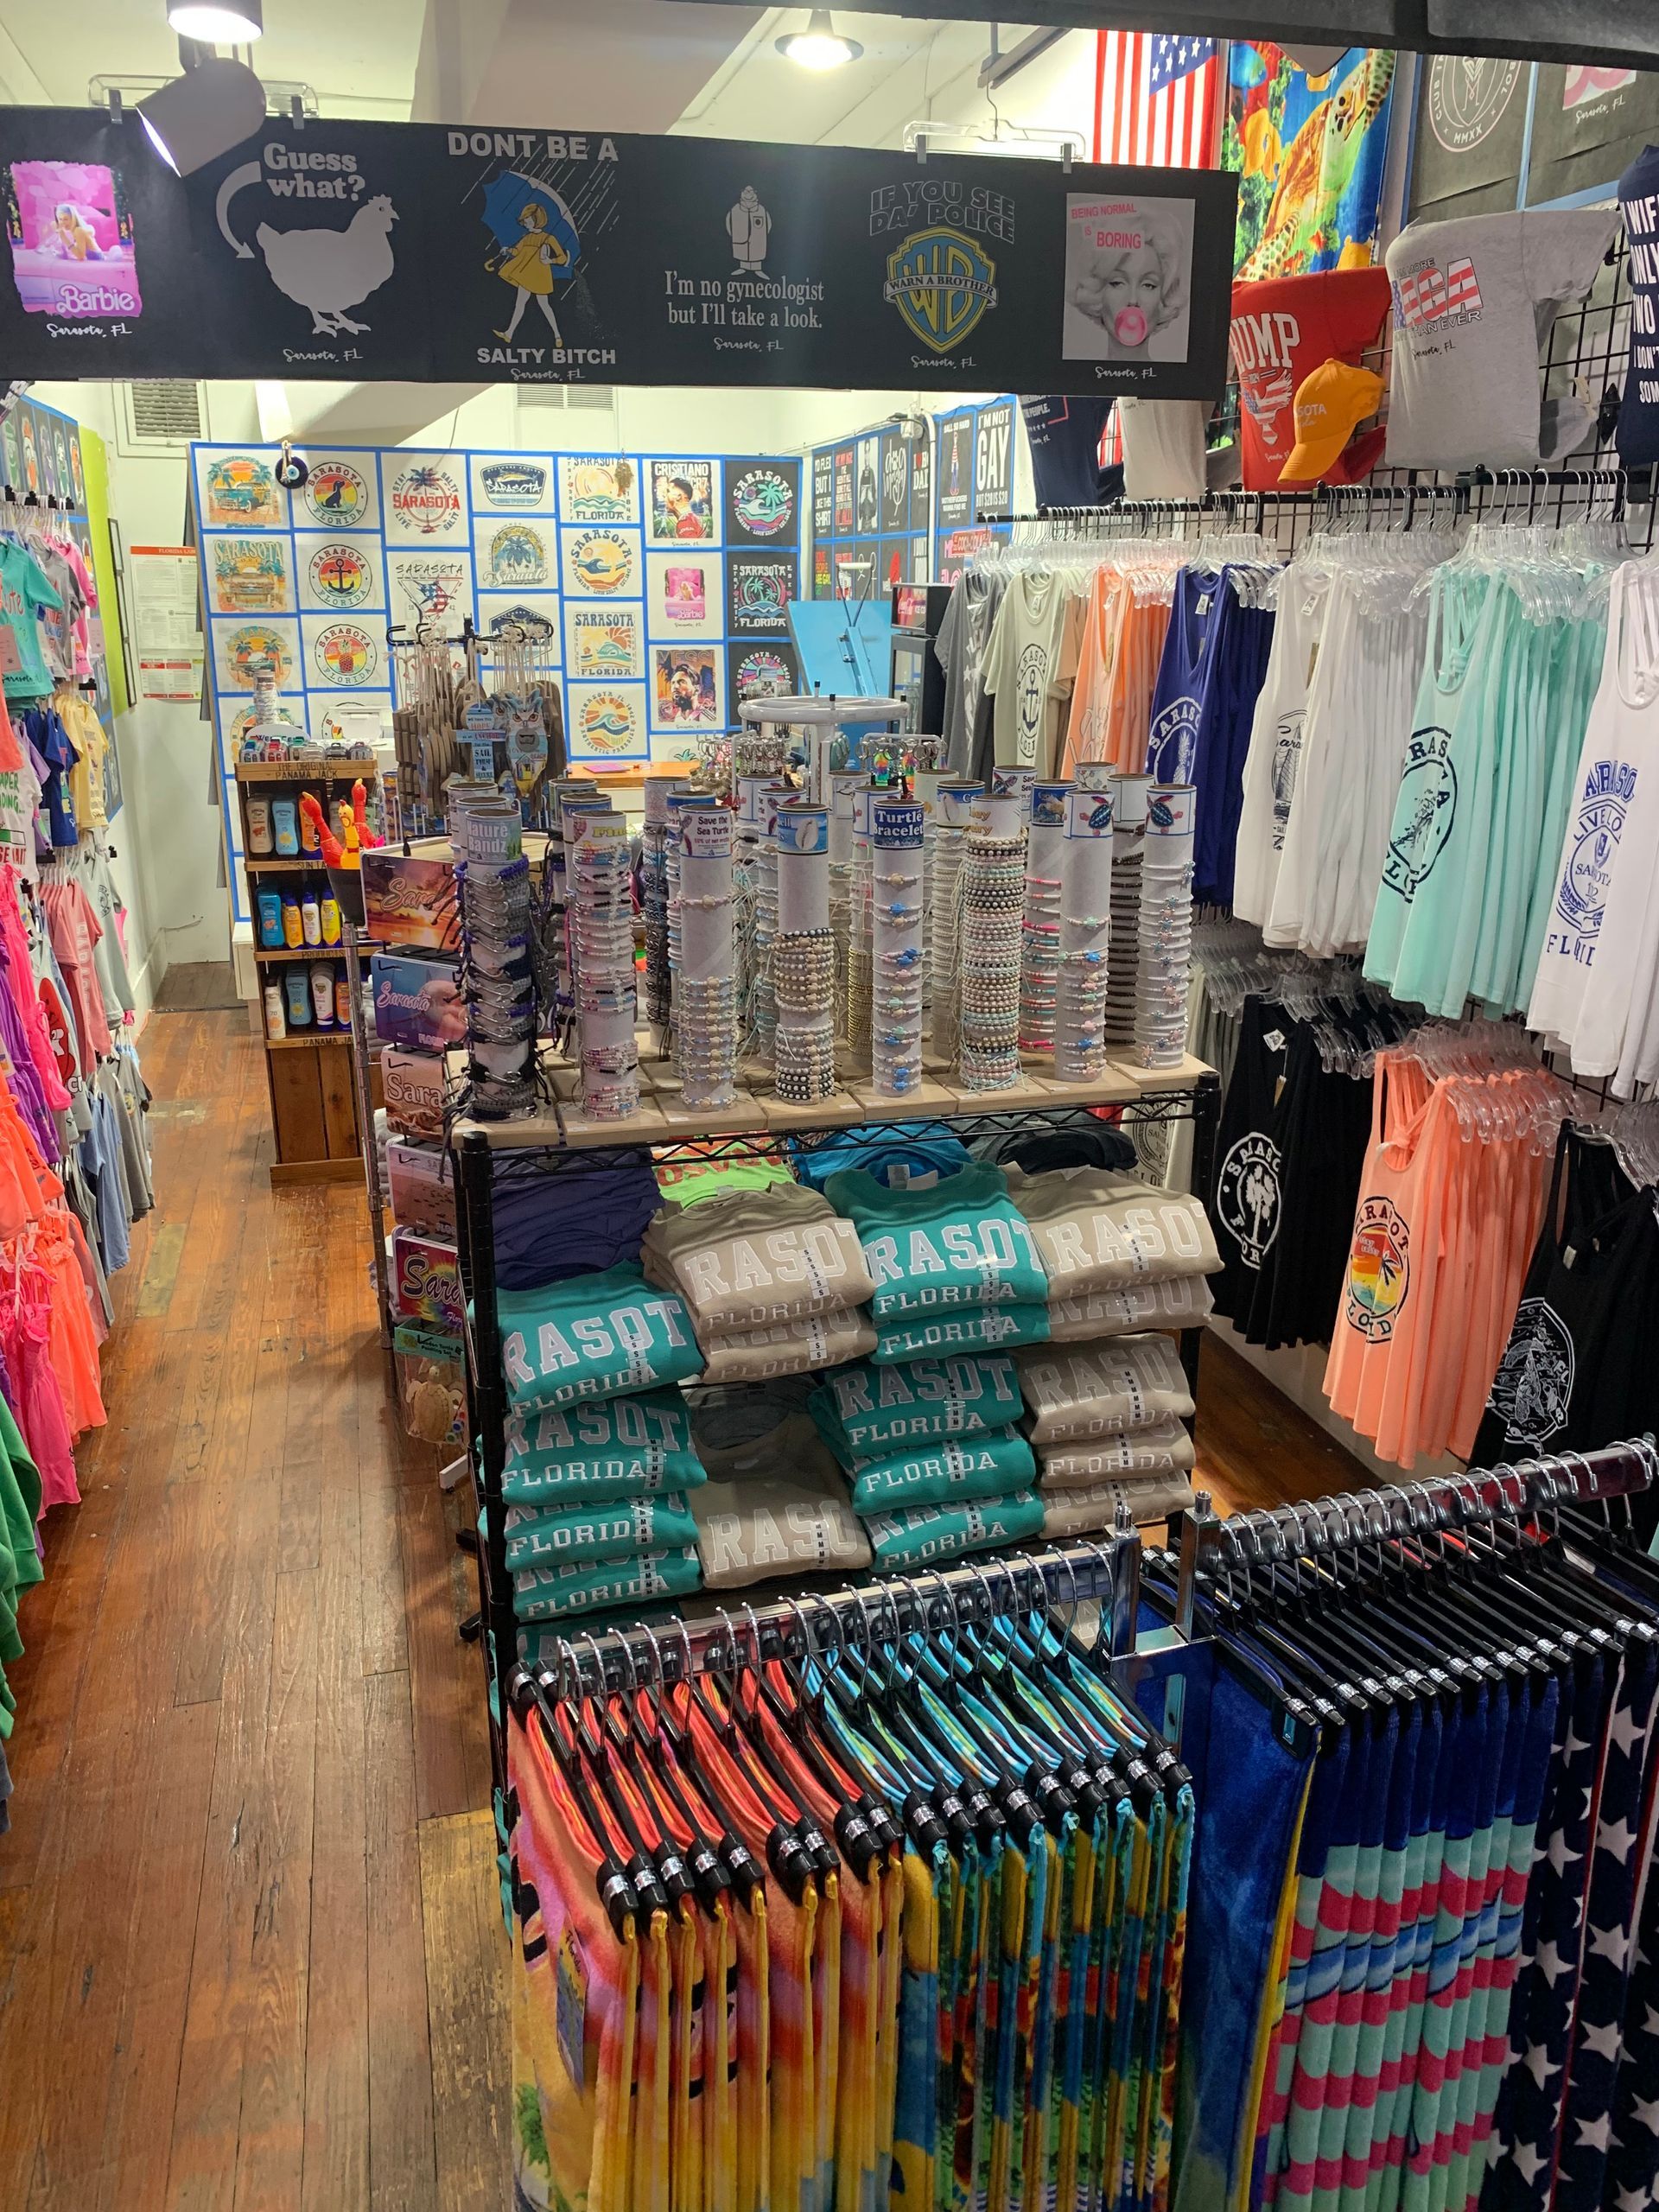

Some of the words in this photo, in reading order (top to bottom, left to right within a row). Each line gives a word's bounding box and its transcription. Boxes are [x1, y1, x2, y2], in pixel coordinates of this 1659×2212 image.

[1433, 79, 1442, 120] CLUB
[1612, 94, 1626, 111] FL
[1453, 124, 1483, 144] MMXX
[447, 131, 537, 158] DONT
[547, 135, 589, 161] BE
[597, 138, 620, 162] A
[264, 143, 358, 173] Guess
[266, 174, 365, 201] what?
[870, 184, 896, 213] IF
[902, 180, 963, 206] YOU
[970, 187, 1016, 218] SEE
[1071, 206, 1098, 219] BEING
[1099, 203, 1137, 218] NORMAL
[1627, 194, 1659, 235] WIF
[869, 204, 918, 237] DA'
[927, 202, 1015, 245] POLICE
[1084, 226, 1092, 237] IS
[1096, 231, 1141, 250] BORING
[664, 270, 695, 297] I'm
[700, 282, 721, 297] no
[726, 276, 824, 306] gynecologist
[889, 276, 925, 291] WARN
[925, 276, 936, 286] A
[936, 276, 995, 296] BROTHER
[56, 284, 135, 314] Barbie
[668, 302, 696, 324] but
[701, 303, 726, 326] I'll
[730, 305, 765, 327] take
[770, 312, 779, 327] a
[784, 308, 823, 328] look.
[1440, 311, 1482, 329] EVER
[47, 323, 107, 338] Sarasota,
[111, 324, 132, 336] FL
[766, 339, 785, 352] FL
[1444, 340, 1456, 353] FL
[283, 348, 340, 363] Sarasota,
[343, 349, 363, 361] FL
[477, 347, 545, 365] SALTY
[552, 348, 616, 365] BITCH
[960, 356, 977, 368] FL
[567, 369, 586, 380] FL
[1141, 366, 1157, 378] FL
[978, 412, 991, 429] I'M
[993, 409, 1010, 426] NOT
[1298, 404, 1327, 416] SOTA
[977, 425, 1010, 491] GAY
[308, 466, 362, 487] SARASOTA
[654, 463, 709, 476] CRISTIANO
[392, 473, 407, 492] STAY
[441, 472, 459, 493] SALTY
[486, 478, 542, 493] SARASOTA
[733, 470, 793, 500] SARASOTA
[816, 475, 827, 494] BUT
[393, 493, 461, 510] SARASOTA
[313, 506, 363, 525] FLORIDA
[395, 512, 410, 530] LIVE
[443, 512, 459, 531] SALTY
[575, 511, 624, 520] FLORIDA
[816, 511, 831, 527] SHIRT
[215, 540, 283, 563] SARASOTA
[570, 530, 632, 559] SARASOTA
[313, 549, 365, 570] SARASOTA
[396, 564, 463, 574] SARASOTA
[740, 564, 786, 576] SARASOTA
[318, 589, 366, 607] FLORIDA
[575, 613, 634, 626] SARASOTA
[740, 618, 786, 627] FLORIDA
[319, 628, 372, 648] SARASOTA
[657, 650, 715, 663] MESSI
[323, 668, 372, 684] FLORIDA
[276, 770, 311, 779] PANAMA
[296, 762, 334, 771] ORIGINAL
[698, 816, 716, 824] Save
[877, 810, 922, 823] Turtle
[468, 838, 507, 853] Bandz
[377, 981, 430, 1011] Sarasota
[302, 1037, 338, 1046] PANAMA
[706, 1294, 848, 1331] FLORIDA
[503, 1300, 687, 1382] RASOT
[833, 1357, 1014, 1421] RASOT
[1048, 1453, 1175, 1476] FLORDA
[500, 1460, 647, 1491] FLORIDA
[509, 1521, 630, 1556] FLORID
[707, 1500, 859, 1573] RASO
